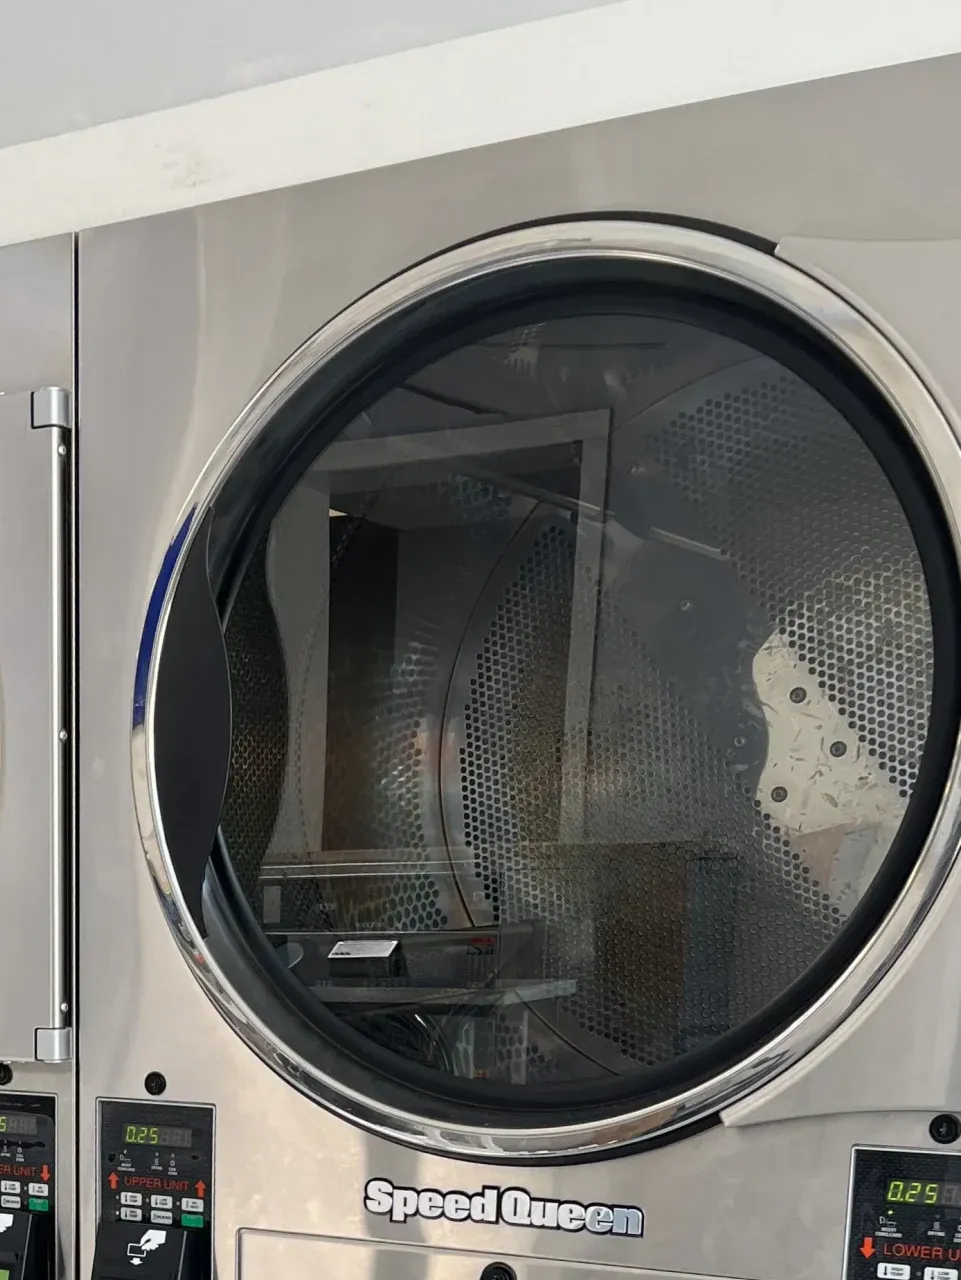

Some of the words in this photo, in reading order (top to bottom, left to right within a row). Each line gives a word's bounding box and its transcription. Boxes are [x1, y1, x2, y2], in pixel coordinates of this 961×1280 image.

[126, 1126, 158, 1144] 0.25
[13, 1166, 37, 1177] UNIT
[124, 1177, 160, 1188] UPPER
[164, 1179, 189, 1190] UNIT
[887, 1181, 938, 1204] 0.25
[364, 1177, 500, 1224] Speed
[499, 1186, 645, 1239] Queen
[883, 1243, 944, 1260] LOWER
